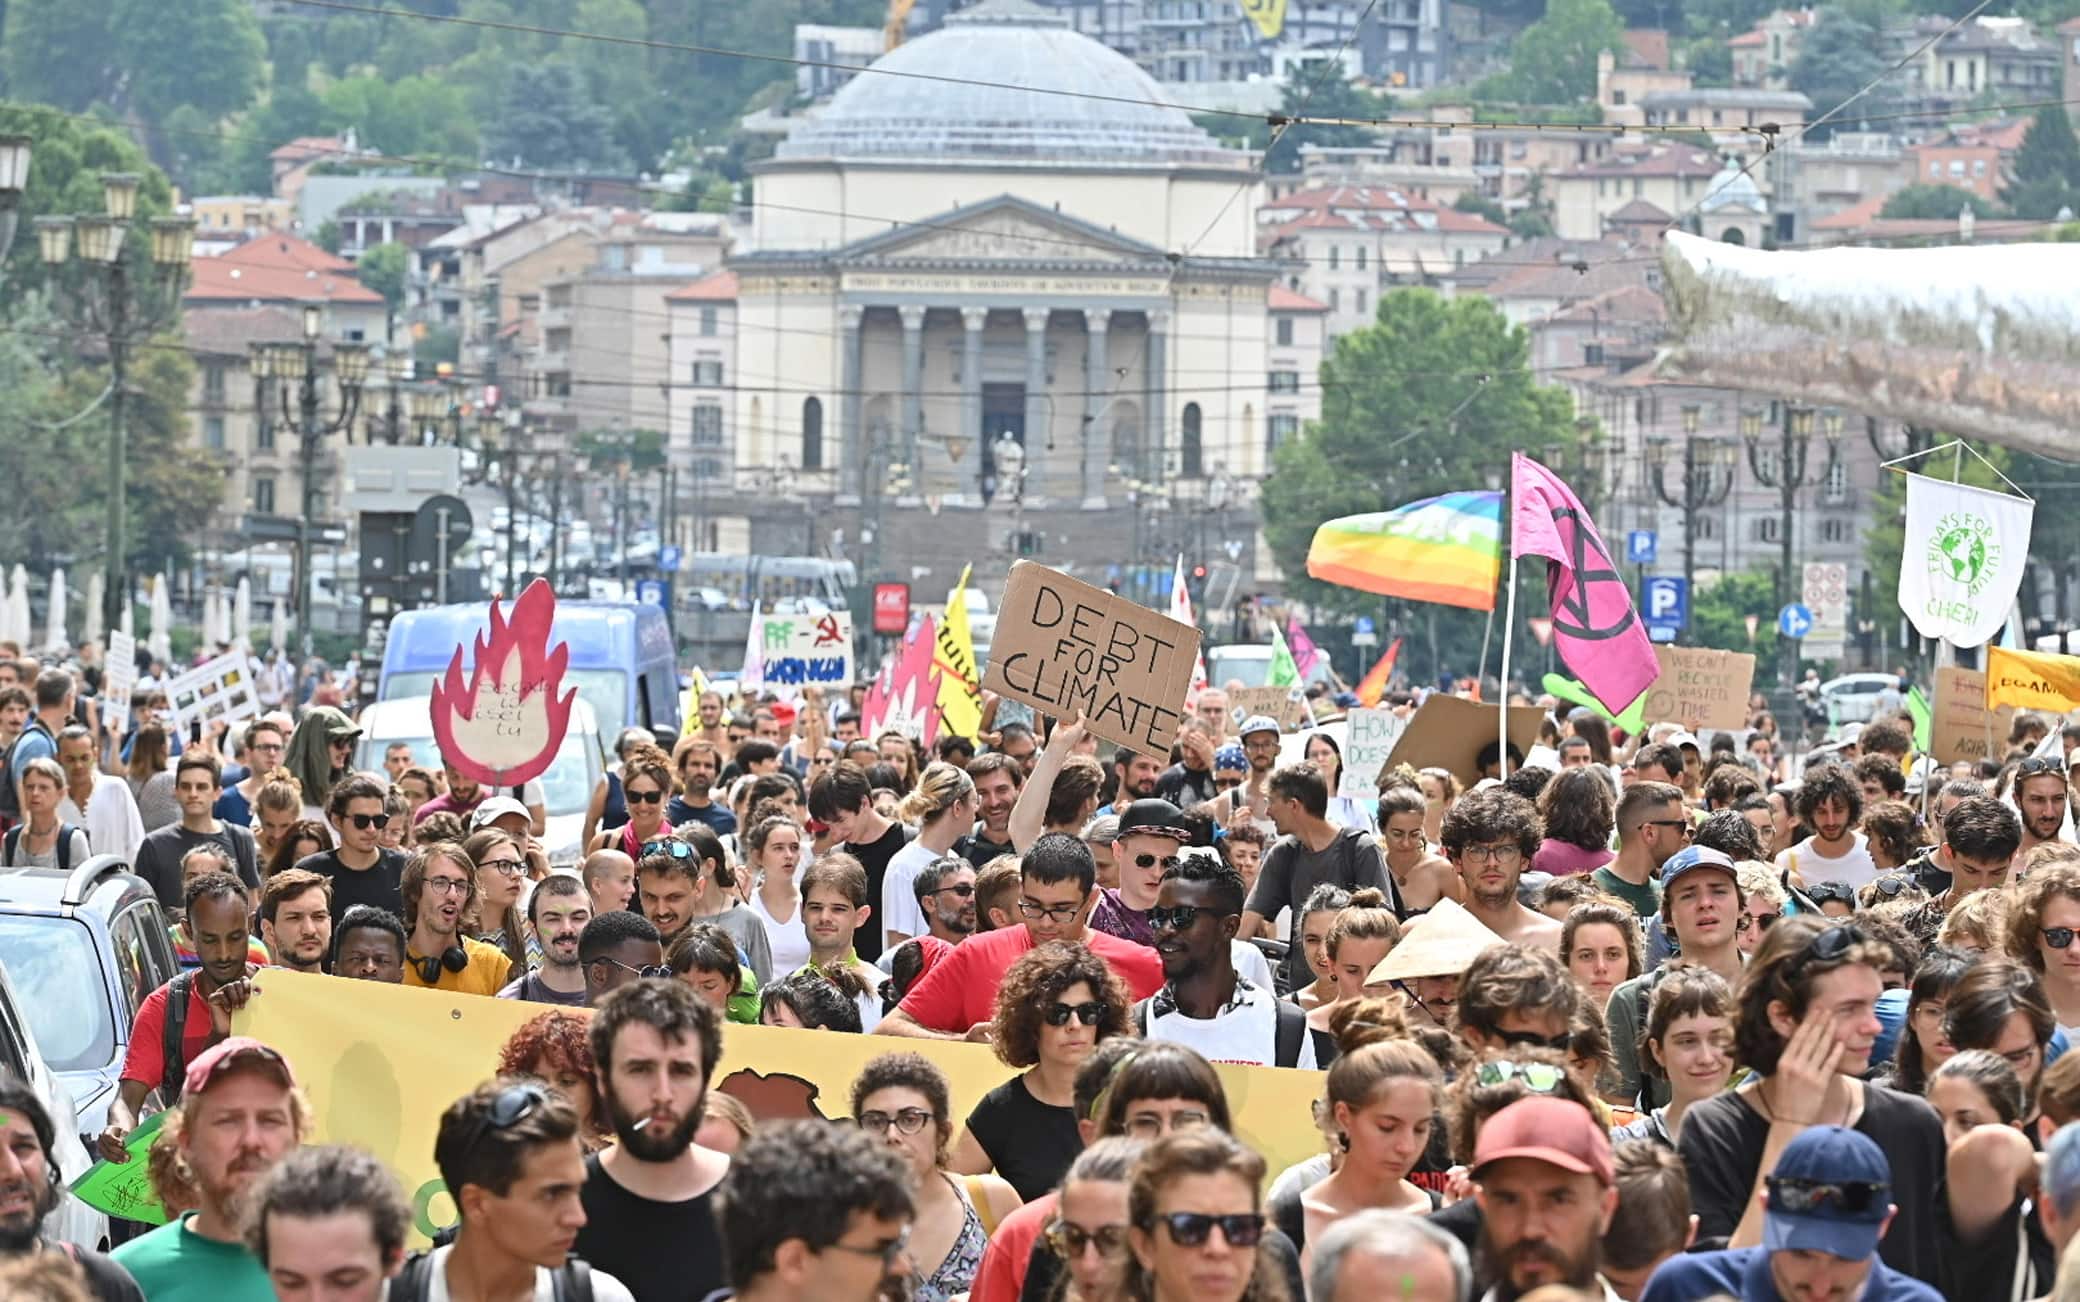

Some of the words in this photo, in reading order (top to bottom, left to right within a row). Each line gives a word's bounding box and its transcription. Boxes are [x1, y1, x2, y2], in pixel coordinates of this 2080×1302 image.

[1964, 512, 1993, 541] FOR
[1634, 534, 1651, 555] P
[1651, 588, 1677, 618] P
[1032, 586, 1175, 674] DEBT
[1053, 639, 1120, 686] FOR
[1671, 655, 1693, 669] WE
[1002, 652, 1179, 753] CLIMATE
[1679, 701, 1712, 719] TIME
[1353, 714, 1396, 742] HOW
[1348, 744, 1391, 766] DOES
